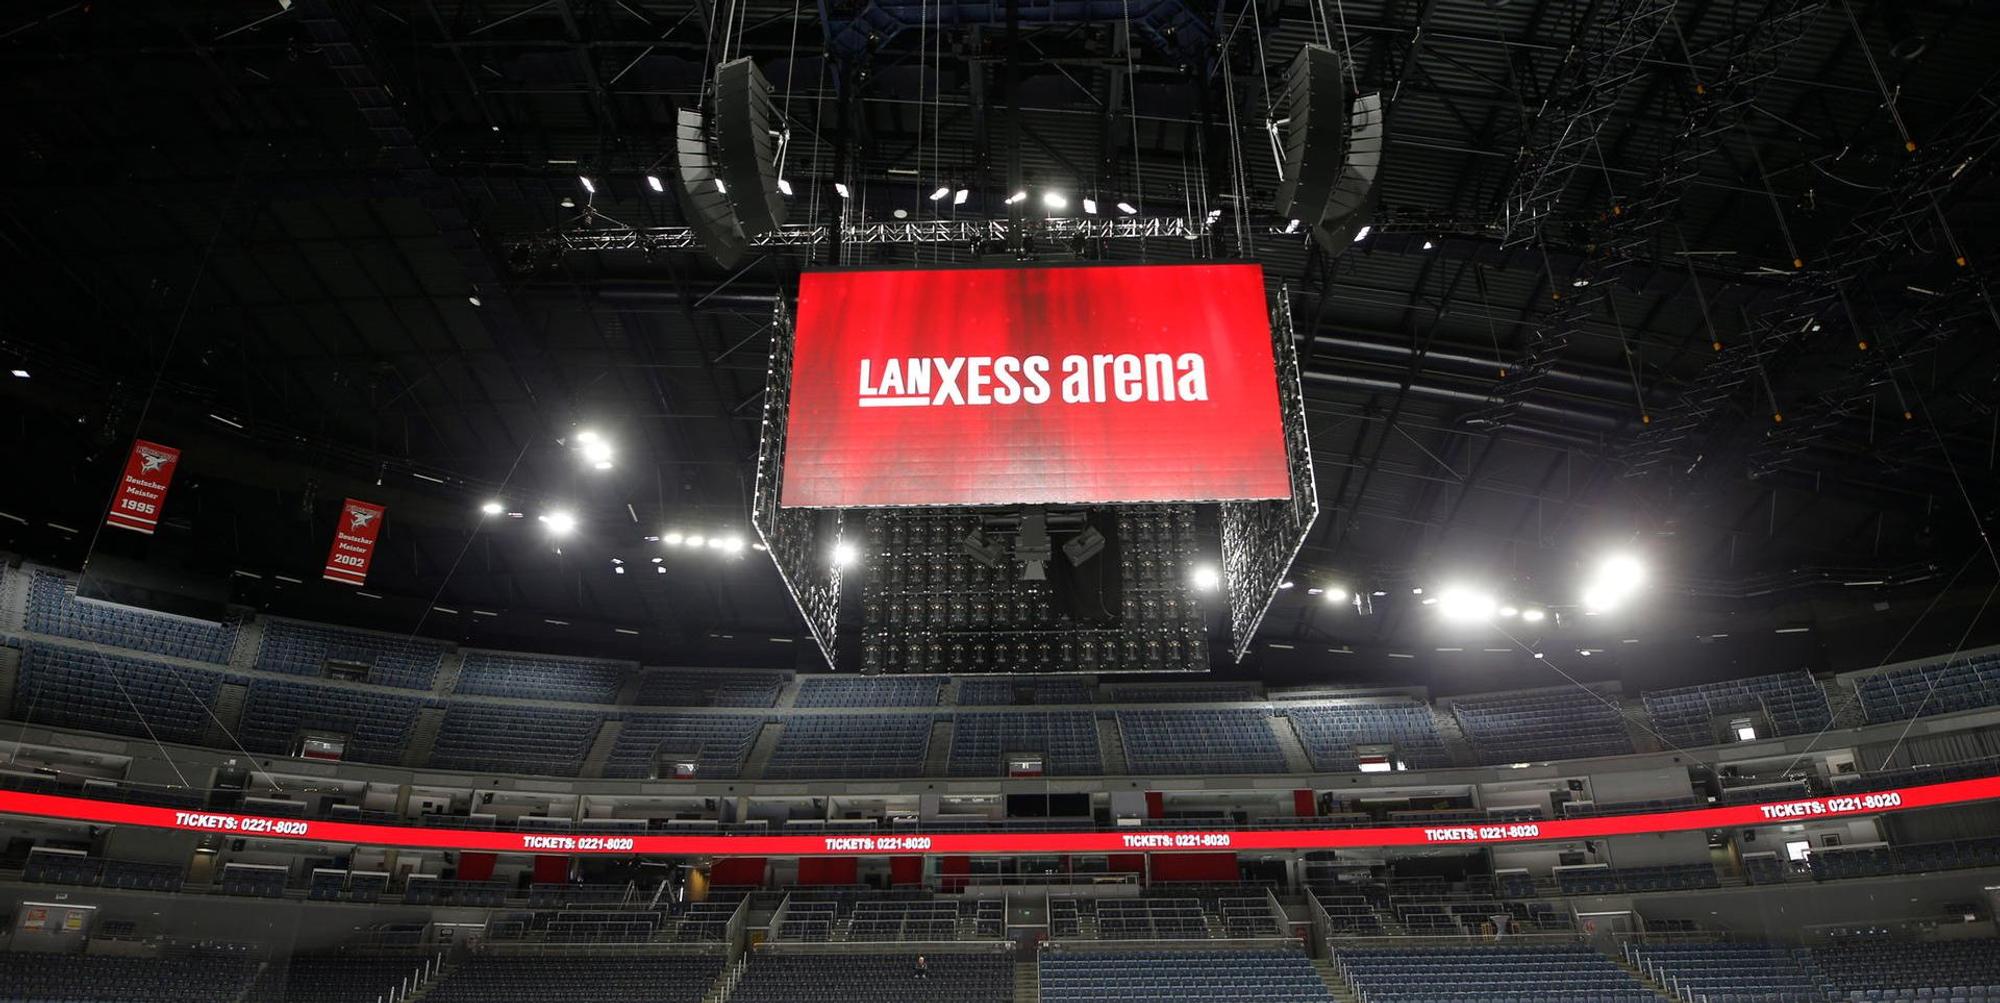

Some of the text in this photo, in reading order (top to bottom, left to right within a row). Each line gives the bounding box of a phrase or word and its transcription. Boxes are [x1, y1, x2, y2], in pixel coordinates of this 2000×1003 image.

[859, 353, 1208, 407] LANXESS arena
[126, 475, 167, 490] Deutscher
[126, 486, 158, 499] Meister
[121, 499, 155, 514] 1995
[338, 532, 373, 545] Deutscher
[339, 543, 367, 553] Meister
[334, 554, 365, 567] 2002
[1760, 793, 1901, 818] TICKETS: 0221-8020
[175, 812, 308, 835] TICKETS: 0221-8020
[1424, 825, 1539, 841] TICKETS: 0221-8020
[523, 836, 634, 850] TICKETS: 0221-8020
[824, 837, 932, 851] TICKETS: 0221-8020
[1122, 834, 1231, 847] TICKETS: 0221-8020
